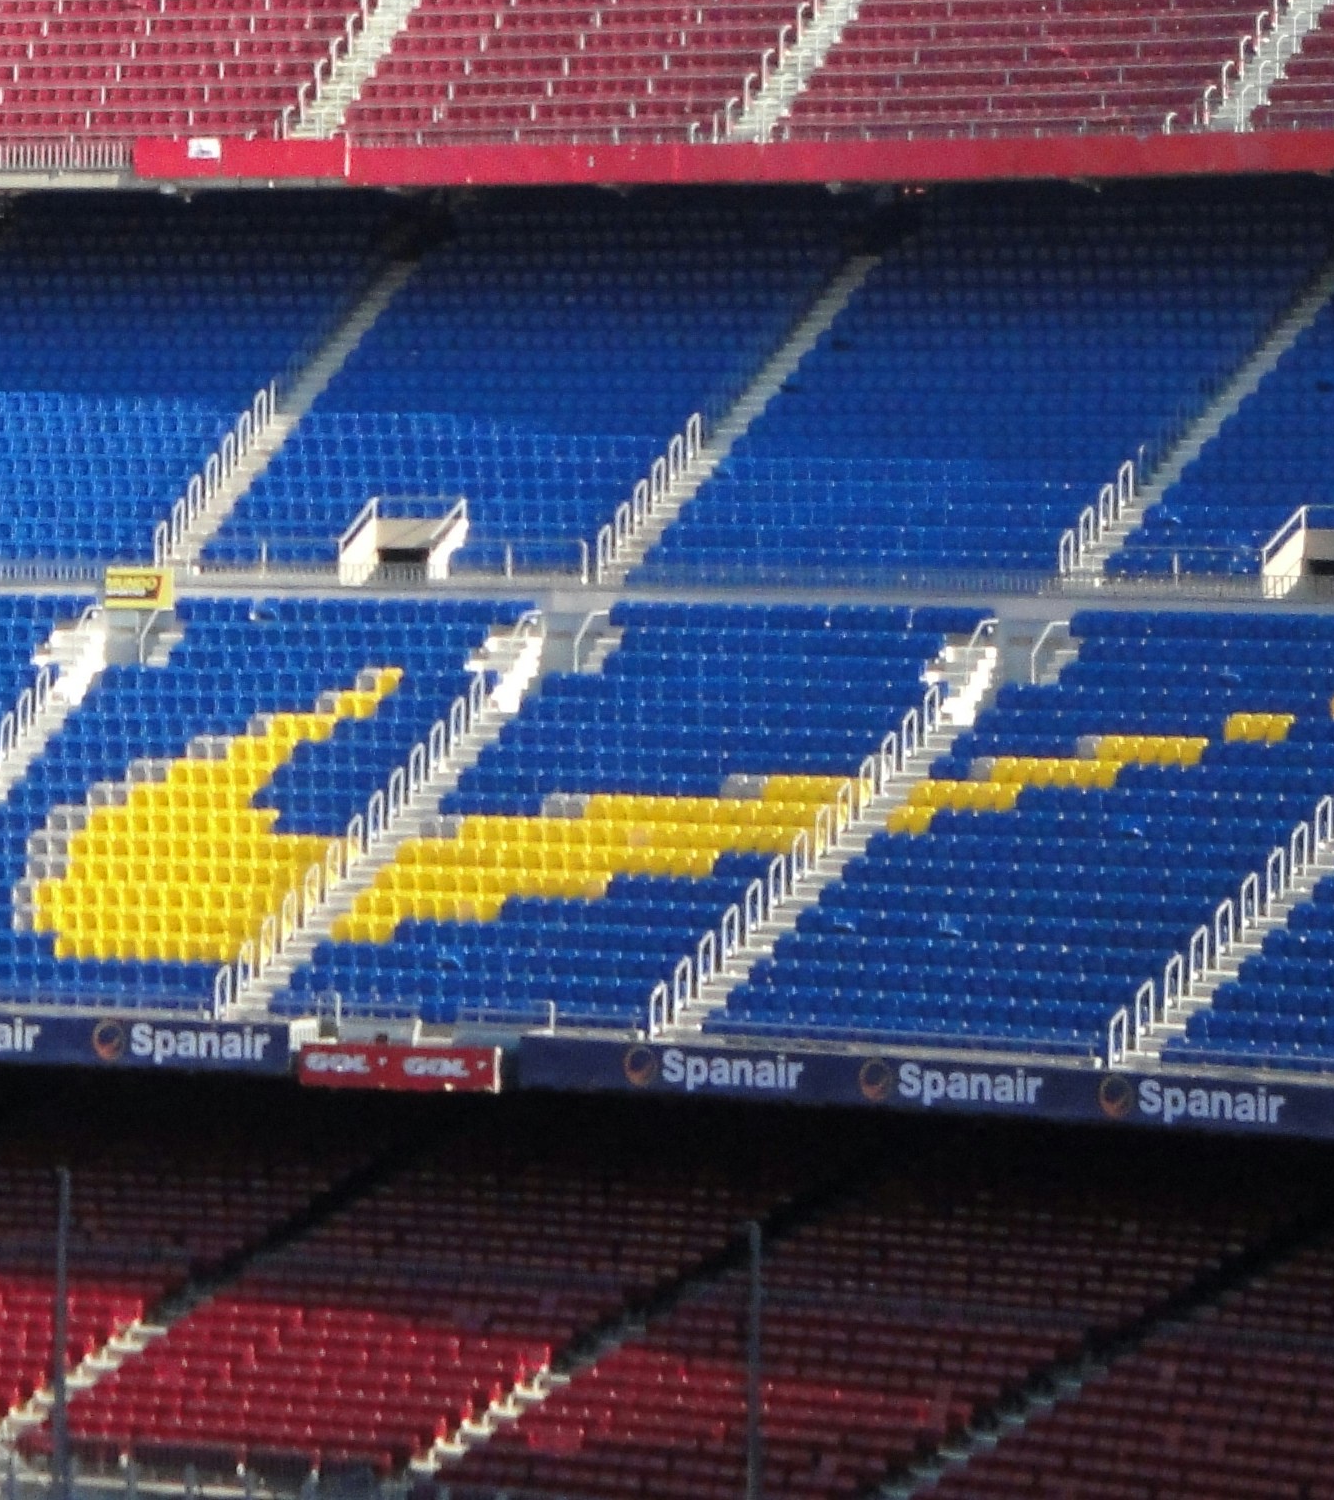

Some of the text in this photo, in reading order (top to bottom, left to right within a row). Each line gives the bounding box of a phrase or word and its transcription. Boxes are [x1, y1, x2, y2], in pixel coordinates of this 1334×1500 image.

[131, 1026, 271, 1063] Spanair
[662, 1049, 803, 1091] Spanair
[897, 1062, 1044, 1106] Spanair
[1138, 1078, 1286, 1125] Spanair
